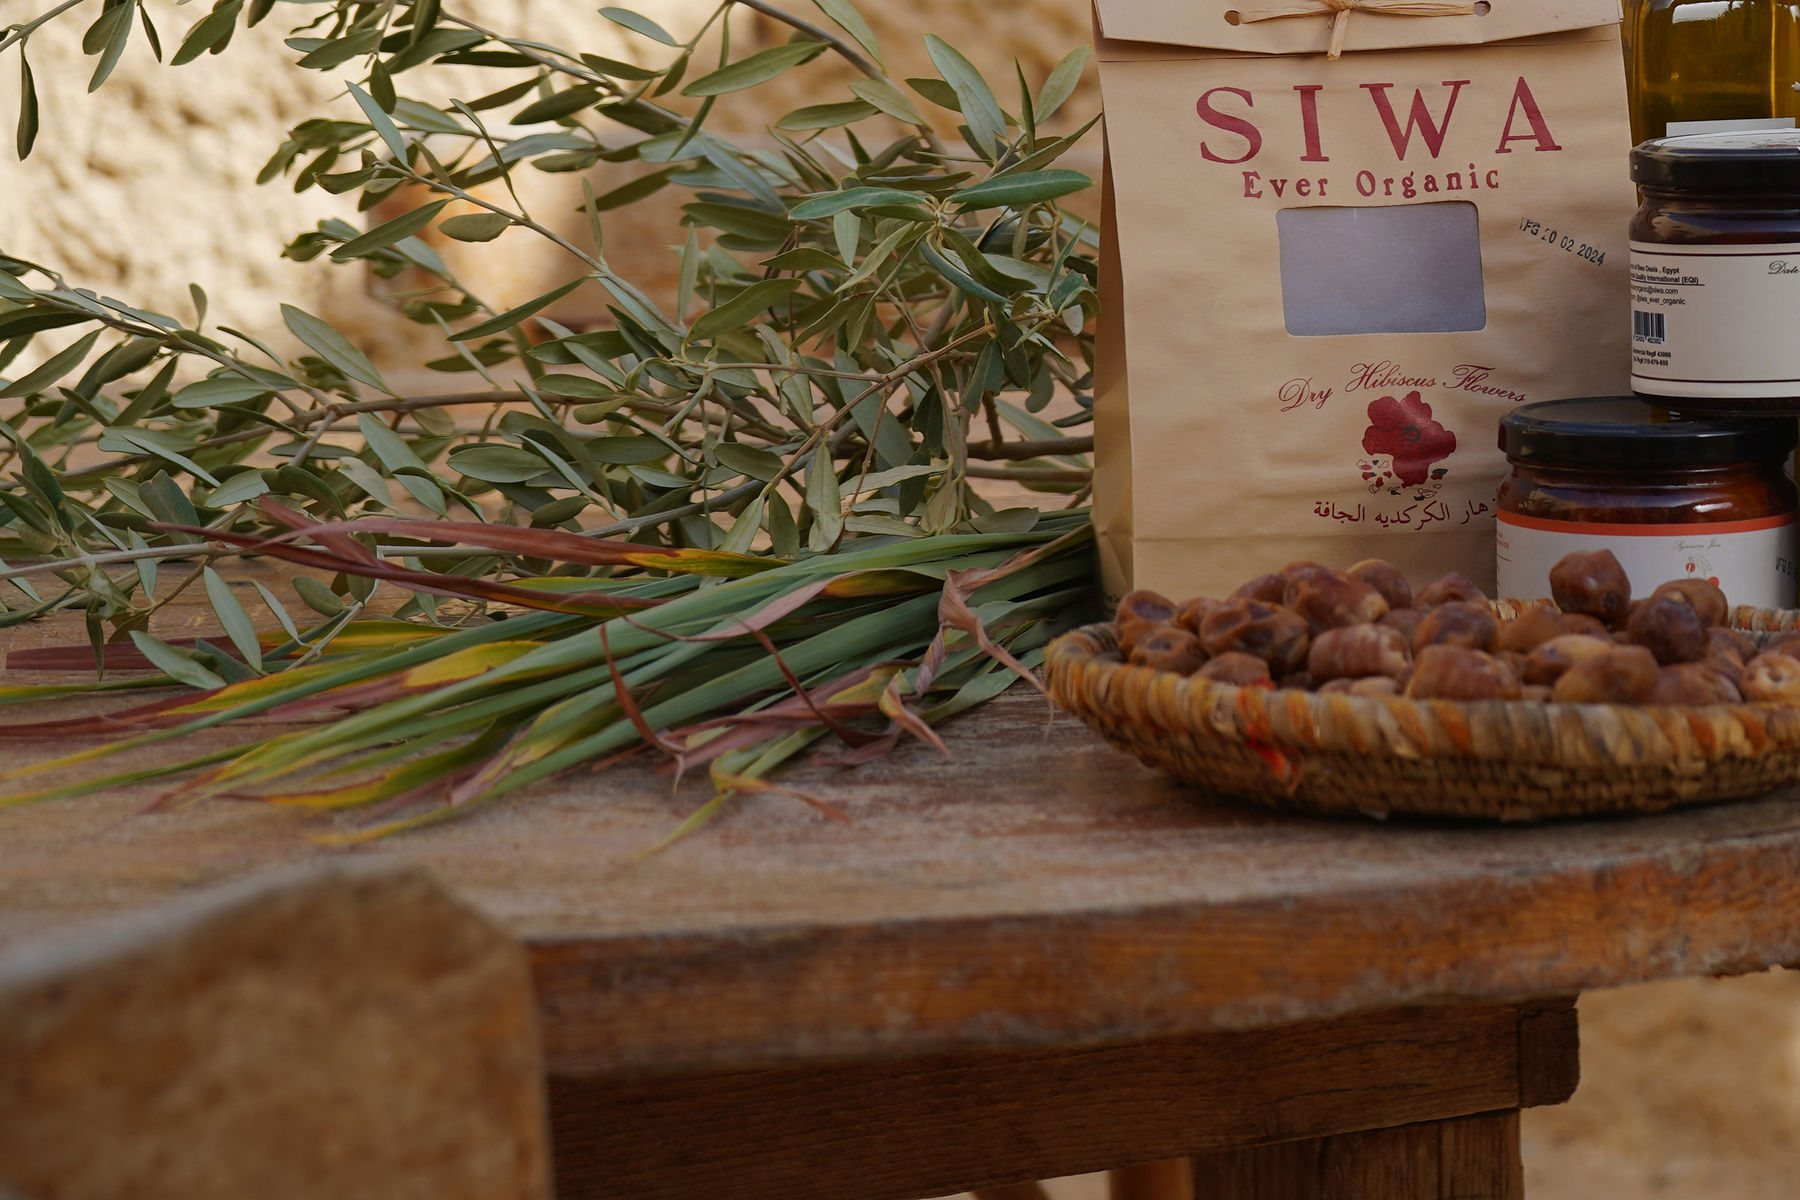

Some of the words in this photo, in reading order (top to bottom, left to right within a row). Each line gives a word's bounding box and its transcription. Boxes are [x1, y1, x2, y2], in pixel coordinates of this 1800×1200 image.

[1195, 75, 1563, 165] SIWA
[1242, 170, 1328, 199] Ever
[1355, 163, 1500, 199] Organic
[1560, 235, 1575, 253] 02
[1577, 243, 1607, 267] 2024
[1662, 266, 1680, 275] Egypt
[1768, 260, 1800, 275] Date
[1278, 377, 1333, 412] Dry
[1344, 360, 1437, 393] Hibiscus
[1443, 363, 1527, 402] Flowers
[1312, 500, 1366, 524] الجافة
[1374, 500, 1451, 531] الكركديه
